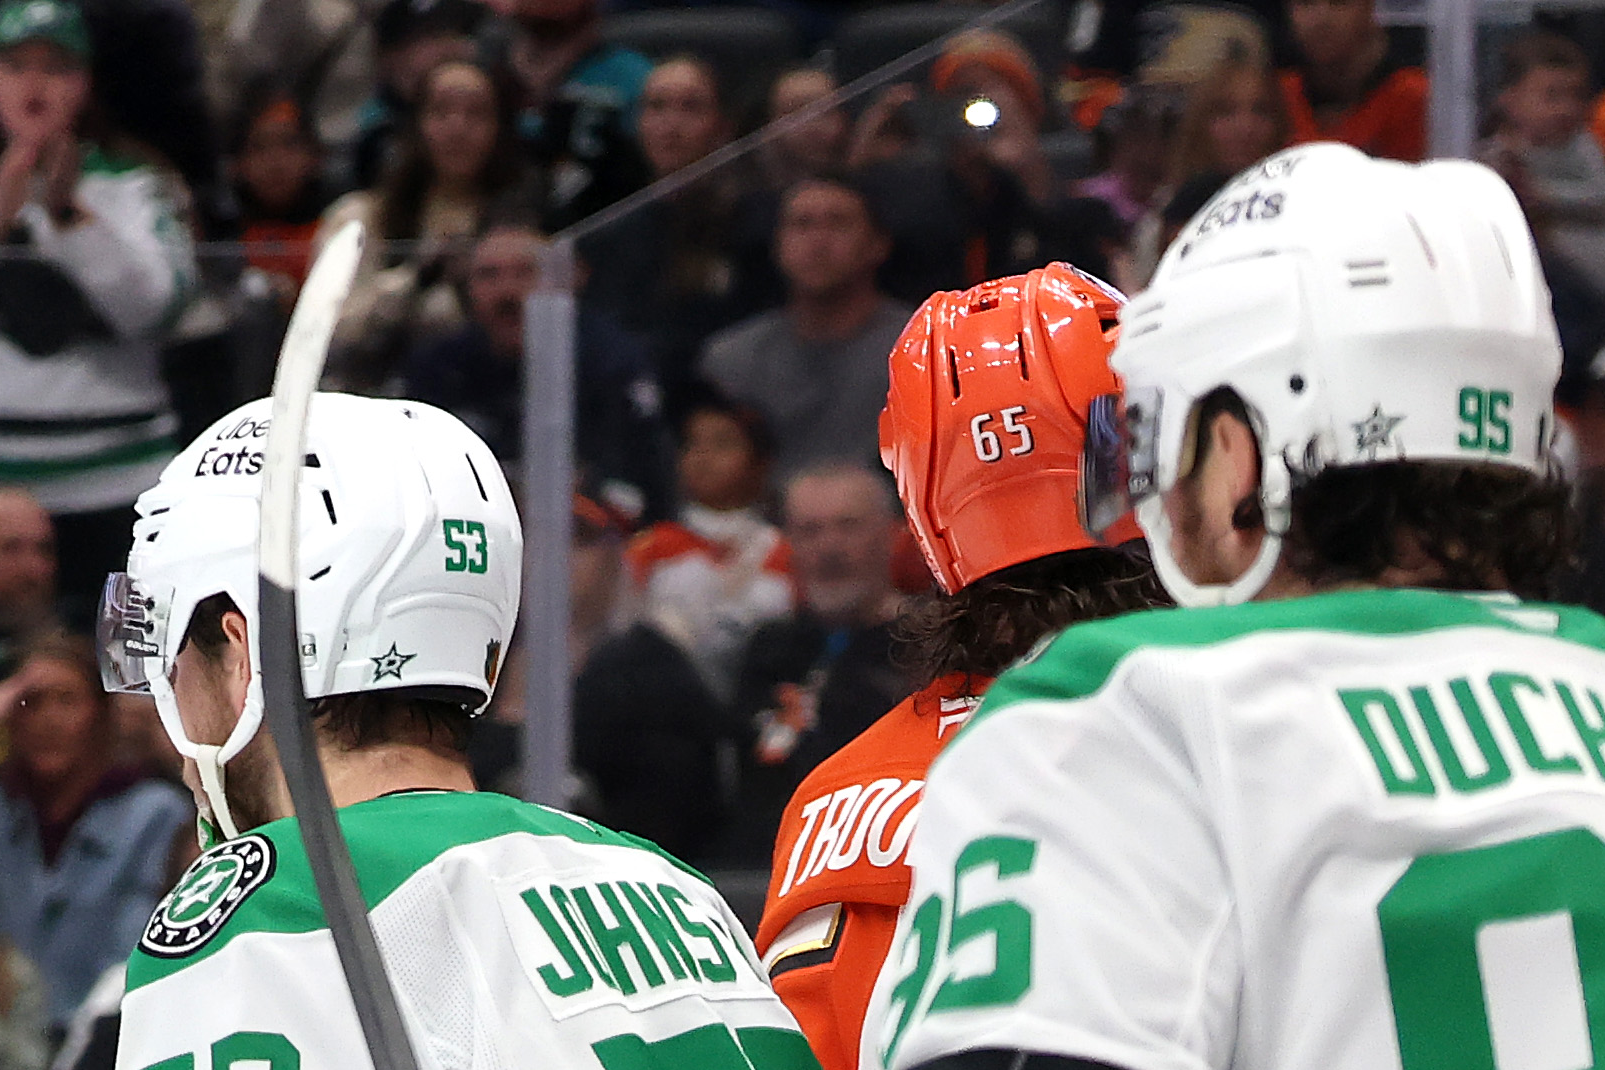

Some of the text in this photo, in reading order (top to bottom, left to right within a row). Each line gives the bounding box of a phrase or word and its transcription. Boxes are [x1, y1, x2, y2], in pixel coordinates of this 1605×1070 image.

[216, 416, 273, 441] Ube
[969, 405, 1035, 464] 65
[1457, 386, 1514, 455] 95
[442, 518, 489, 574] 53
[778, 777, 928, 898] TROU
[518, 879, 739, 998] JOHNS
